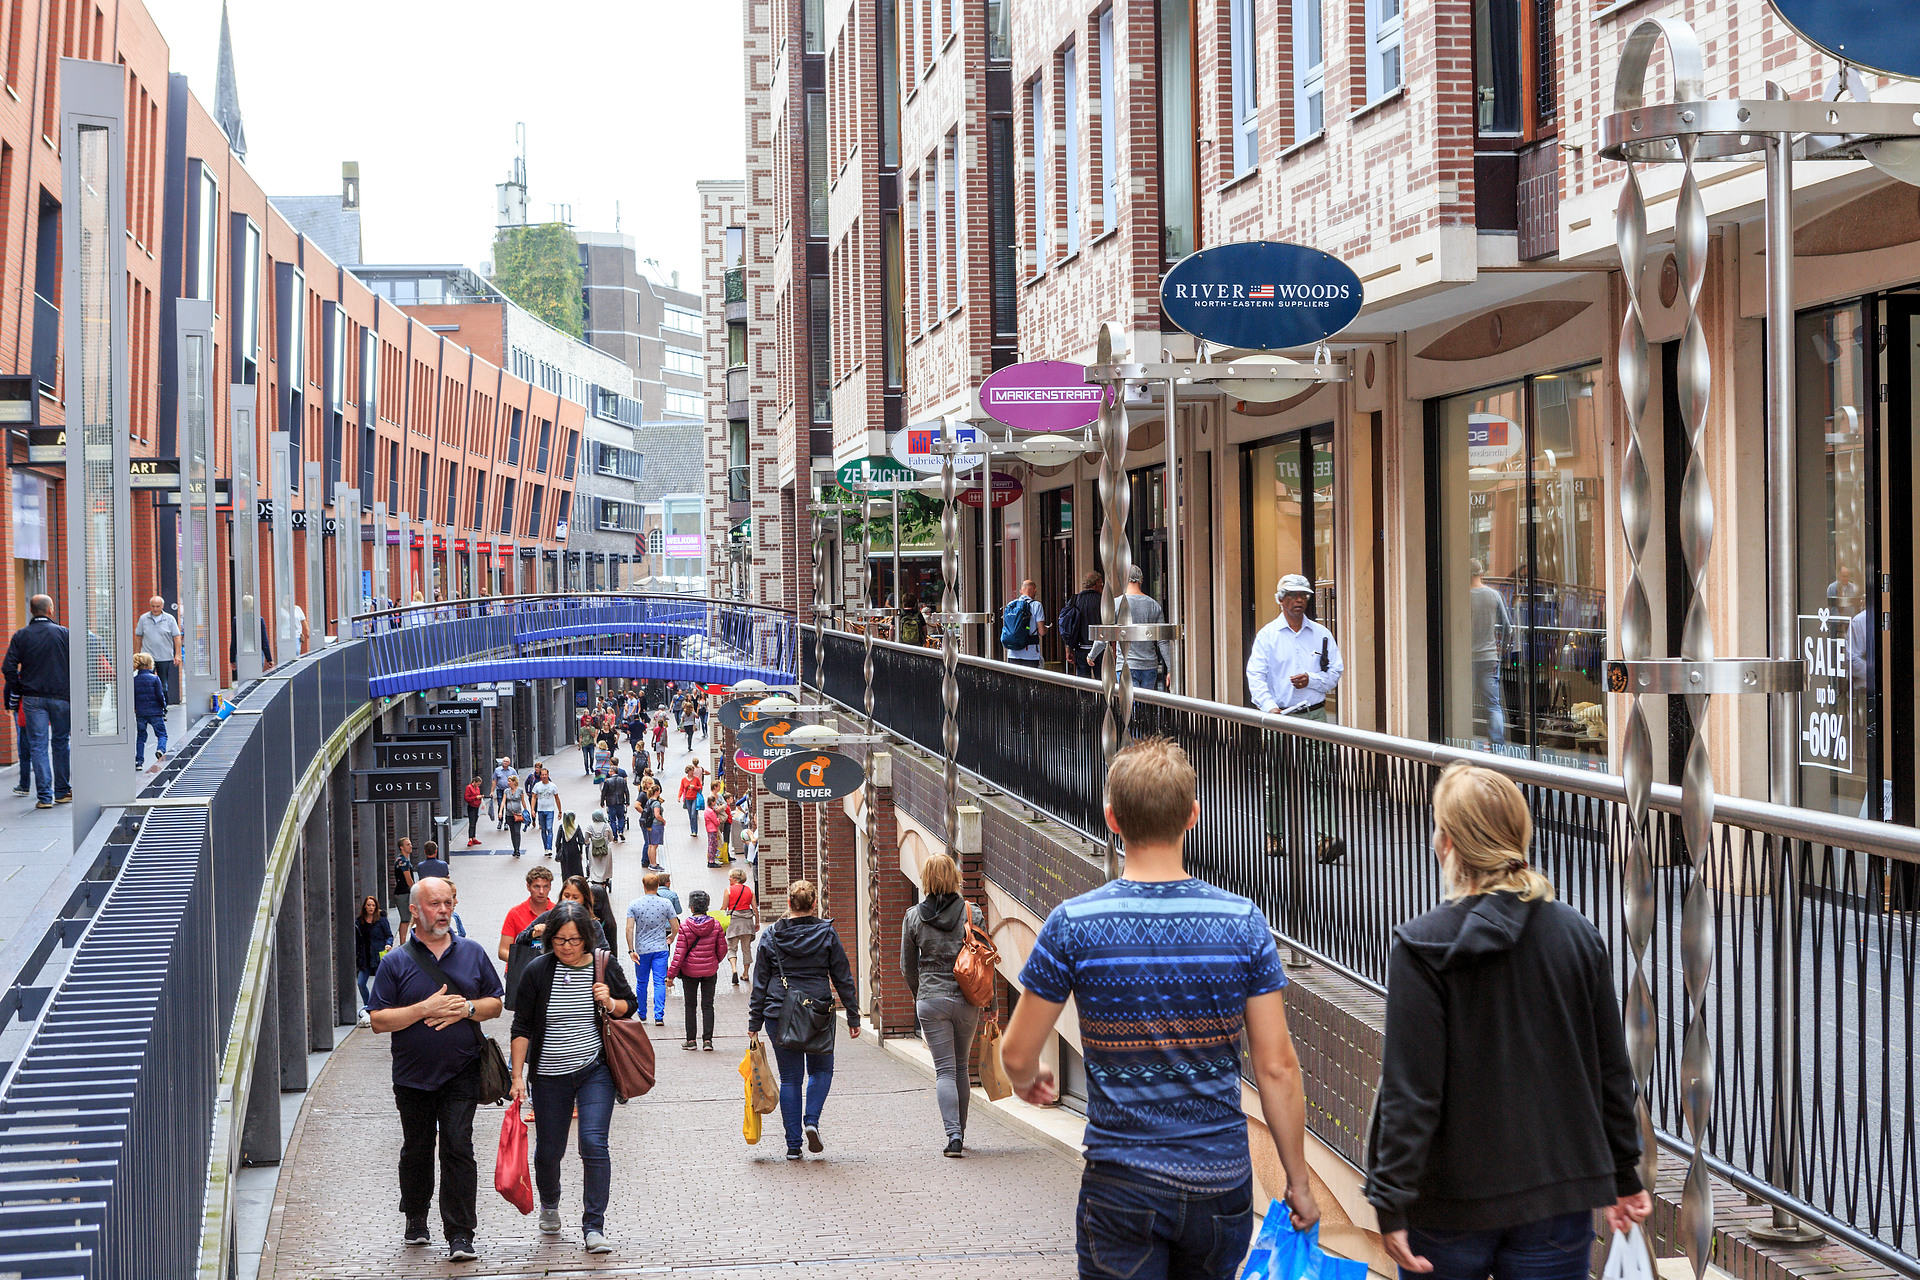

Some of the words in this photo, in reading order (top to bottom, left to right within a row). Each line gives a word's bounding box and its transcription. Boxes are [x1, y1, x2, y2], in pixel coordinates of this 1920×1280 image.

[1175, 284, 1245, 299] RIVER
[1279, 284, 1350, 299] WOODS
[1194, 300, 1275, 308] NORTH-EASTERN
[1278, 300, 1330, 308] SUPPLIERS
[995, 389, 1099, 401] MARIKENSTRAAT
[130, 462, 158, 474] ART
[666, 536, 698, 545] WELKOM
[1804, 635, 1847, 678] SALE
[1816, 686, 1826, 707] up
[1827, 684, 1836, 705] to
[422, 723, 462, 731] COSTES
[1802, 711, 1847, 761] -60%
[394, 751, 442, 761] COSTES
[763, 748, 792, 757] BEVER
[375, 781, 432, 792] COSTES
[796, 788, 832, 798] BEVER
